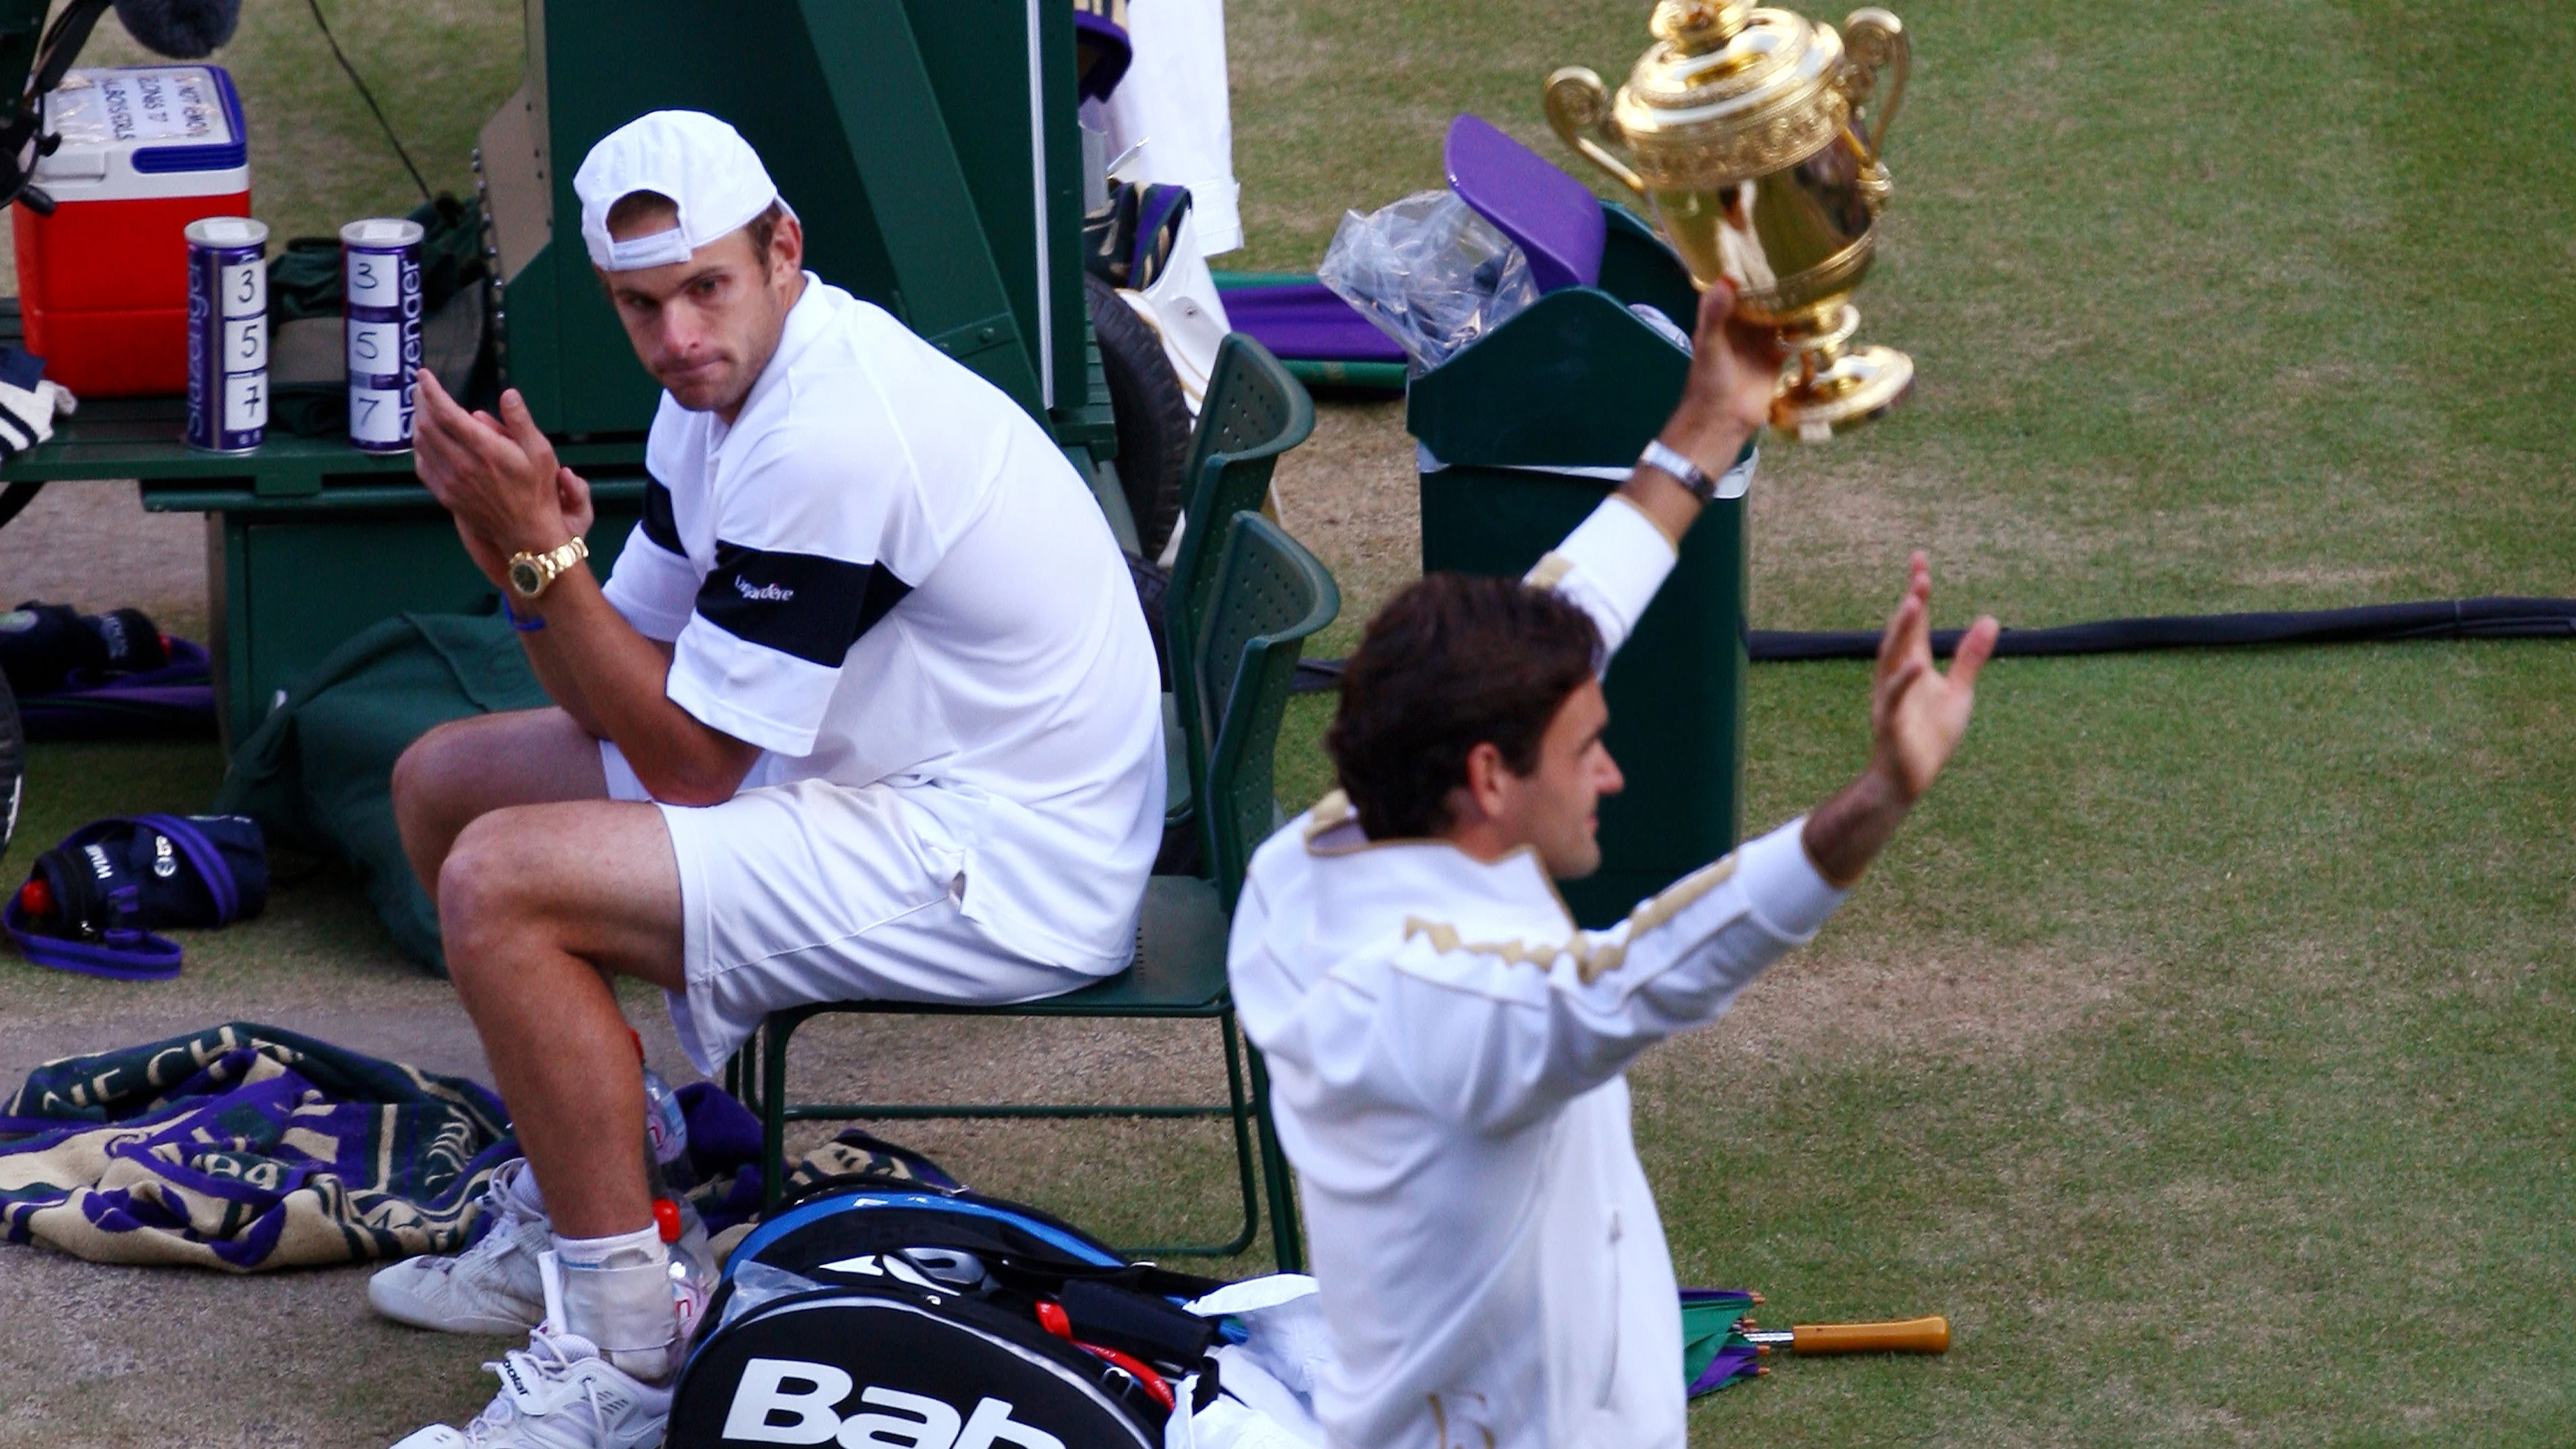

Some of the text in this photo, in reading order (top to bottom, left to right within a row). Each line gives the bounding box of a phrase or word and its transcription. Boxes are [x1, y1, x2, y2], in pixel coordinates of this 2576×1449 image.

[238, 269, 255, 304] 3
[354, 262, 379, 290] 3
[241, 324, 258, 359] 5
[355, 331, 378, 360] 5
[243, 384, 262, 418] 7
[357, 396, 380, 428] 7
